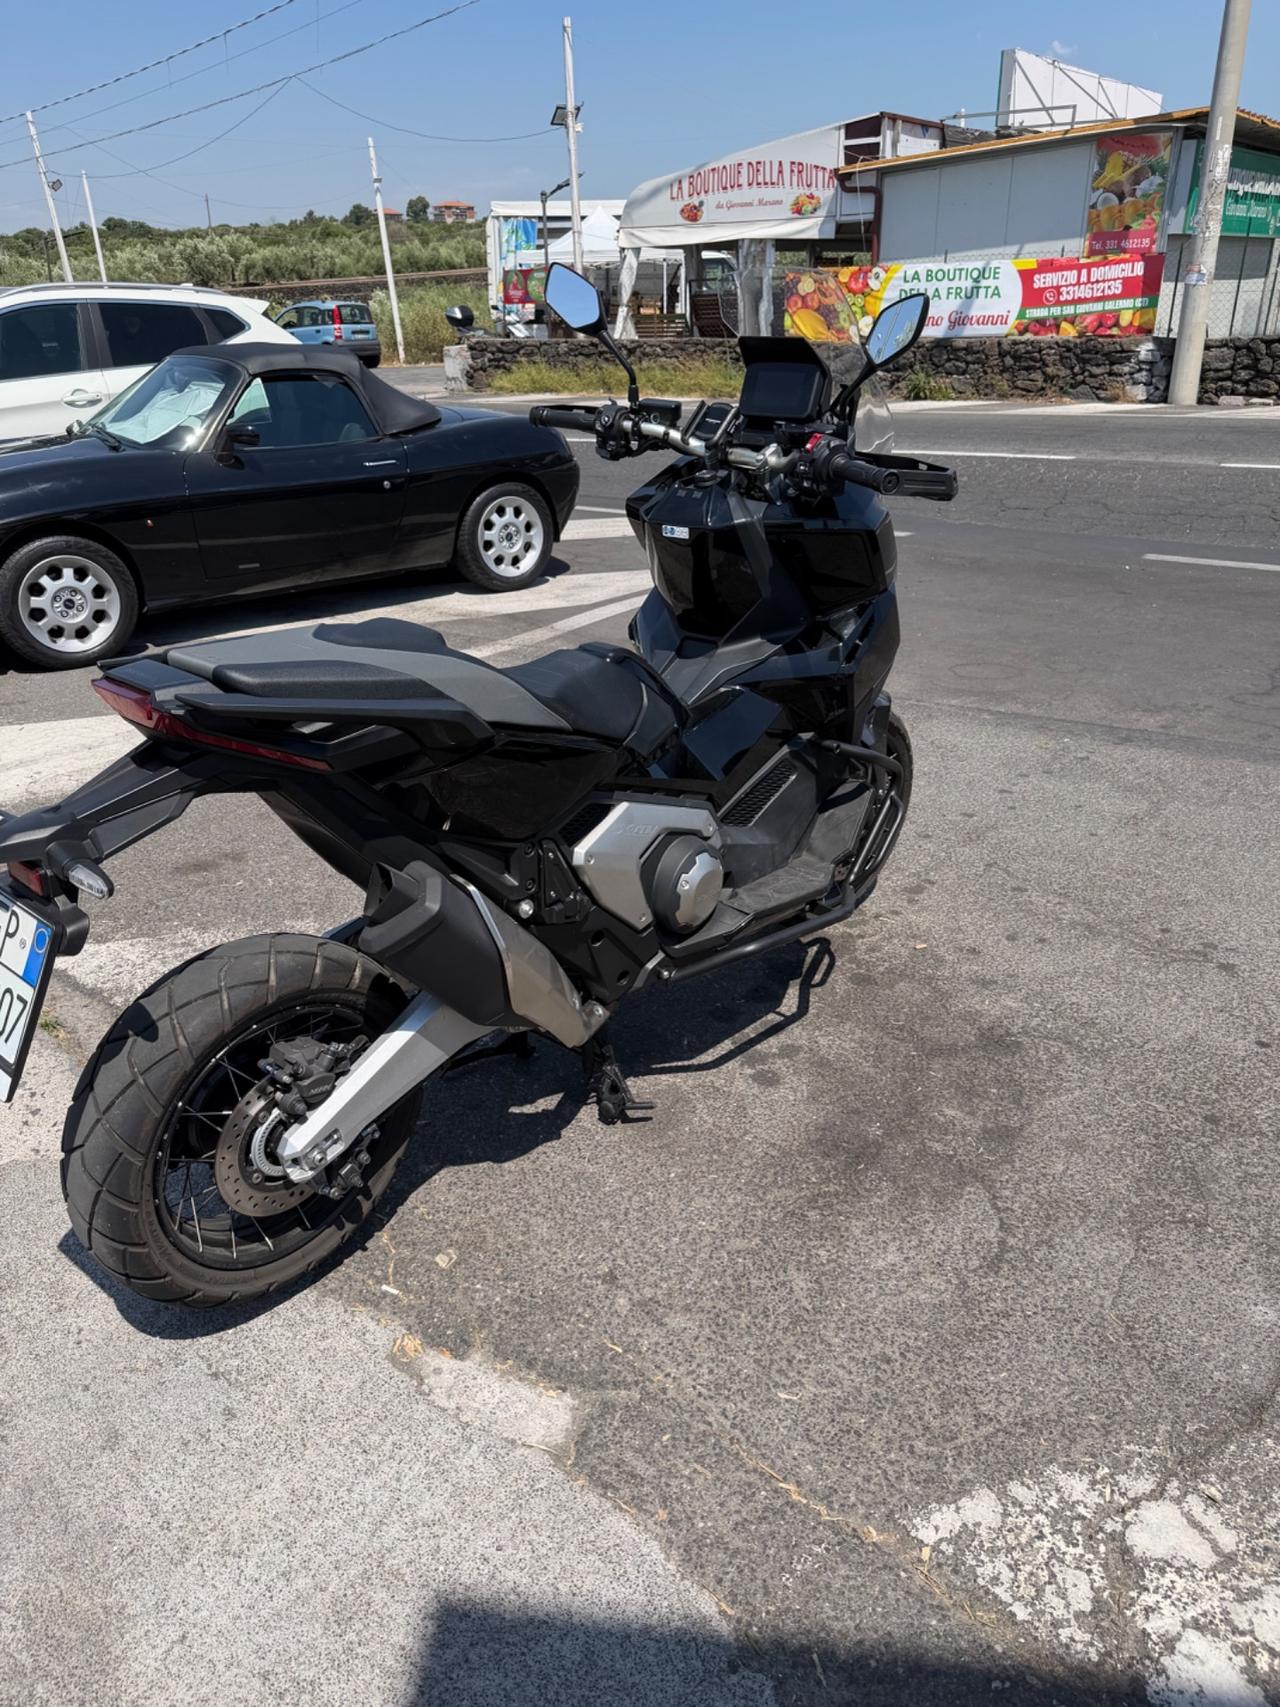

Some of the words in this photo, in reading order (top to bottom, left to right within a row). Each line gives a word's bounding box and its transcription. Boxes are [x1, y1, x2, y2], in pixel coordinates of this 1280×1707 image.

[670, 179, 684, 200] LA
[688, 163, 743, 197] BOUTIQUE
[747, 160, 785, 187] DELLA
[790, 161, 836, 189] FRUTTA
[1105, 240, 1118, 249] 331
[1121, 238, 1151, 249] 4612135
[903, 270, 921, 283] LA
[926, 266, 1001, 284] BOUTIQUE
[1033, 270, 1078, 289] SERVIZIO
[1080, 268, 1088, 283] A
[1090, 261, 1145, 282] DOMICILIO
[946, 286, 1001, 300] FRUTTA
[1059, 280, 1123, 301] 3314612135
[925, 315, 944, 327] no
[947, 310, 1011, 331] Giovanni
[1025, 308, 1049, 318] STRADA
[1049, 306, 1061, 316] PER
[1062, 305, 1075, 315] SAN
[0, 909, 20, 959] P
